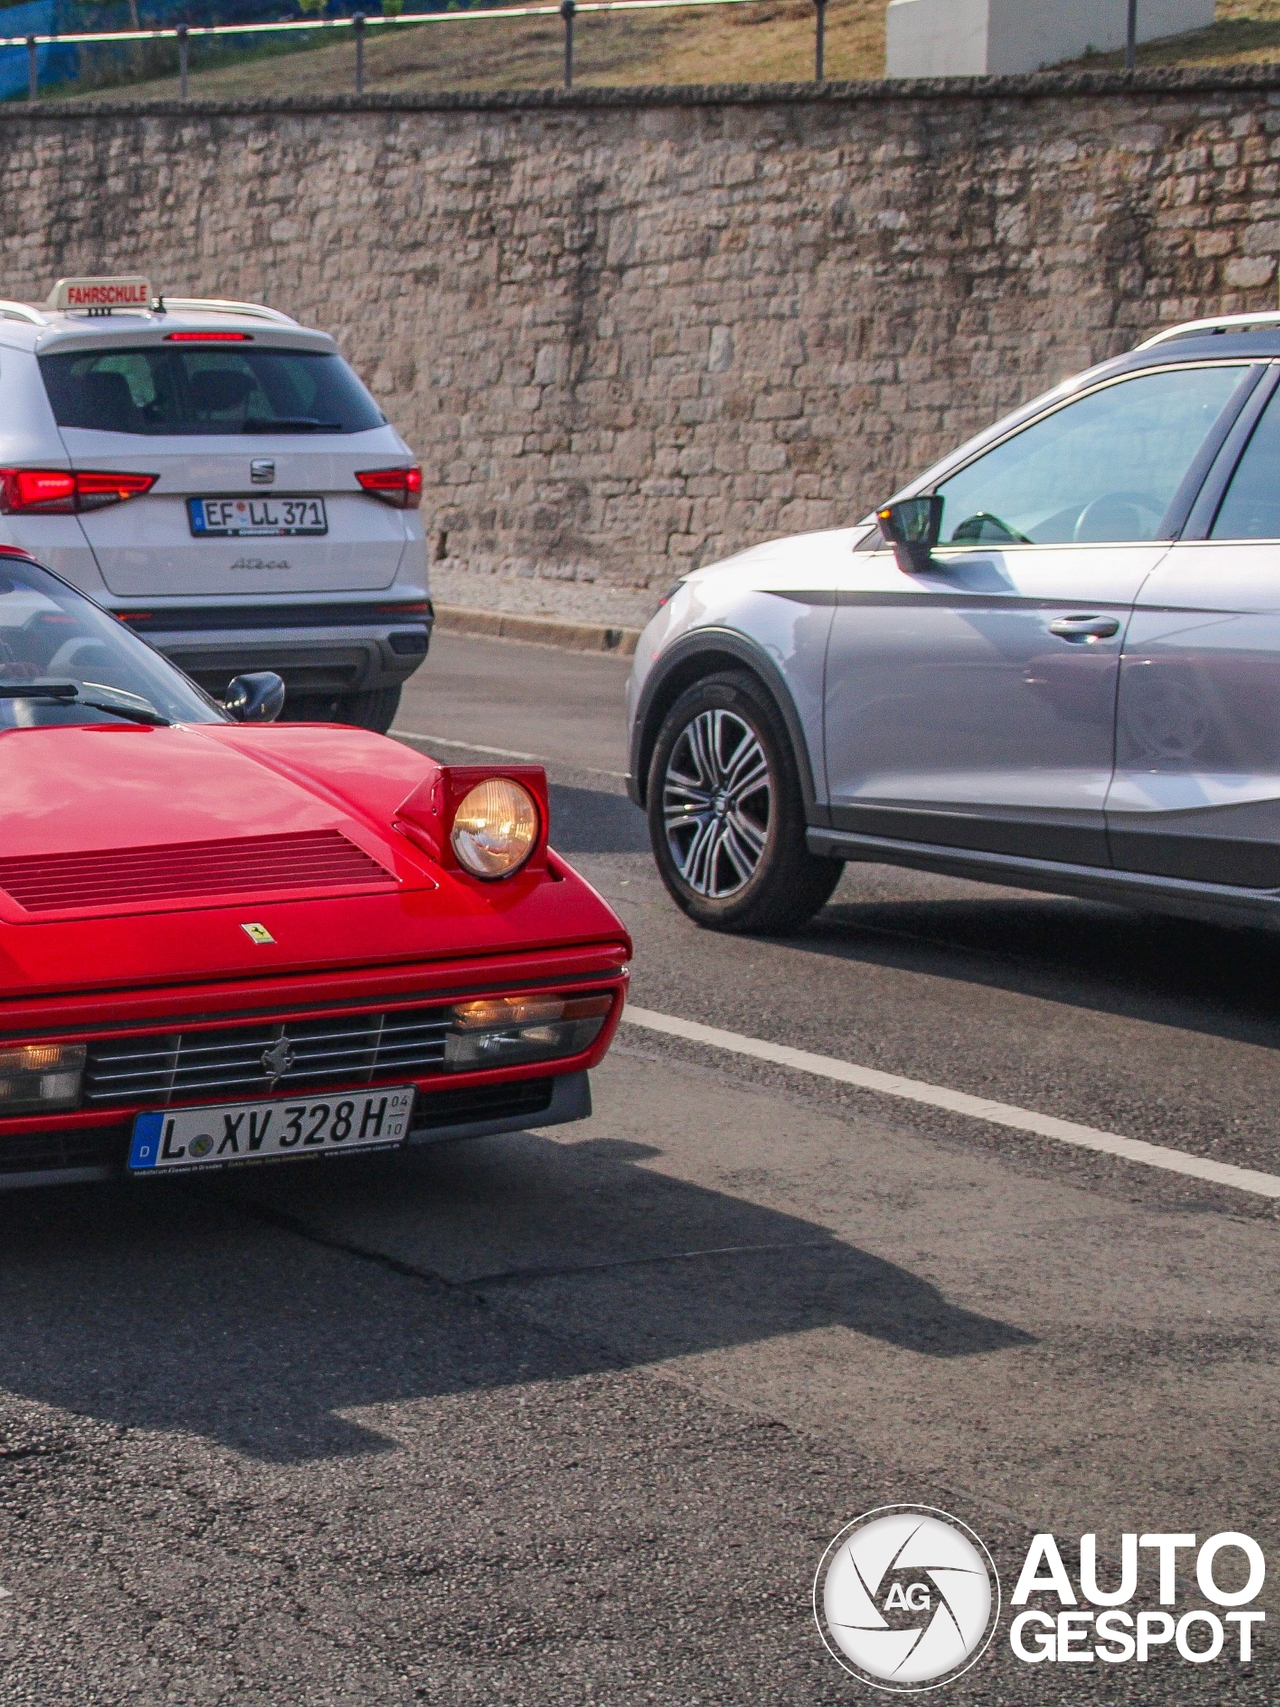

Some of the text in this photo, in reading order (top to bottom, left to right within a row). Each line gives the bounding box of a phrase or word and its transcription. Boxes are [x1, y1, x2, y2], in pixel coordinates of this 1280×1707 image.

[67, 284, 148, 304] FAHRSCHULE
[206, 502, 233, 525] EF
[249, 502, 278, 525] LL
[282, 501, 322, 525] 371
[391, 1094, 408, 1108] 04
[162, 1096, 388, 1159] L XV 328 H
[386, 1123, 403, 1135] 10
[140, 1146, 150, 1157] D
